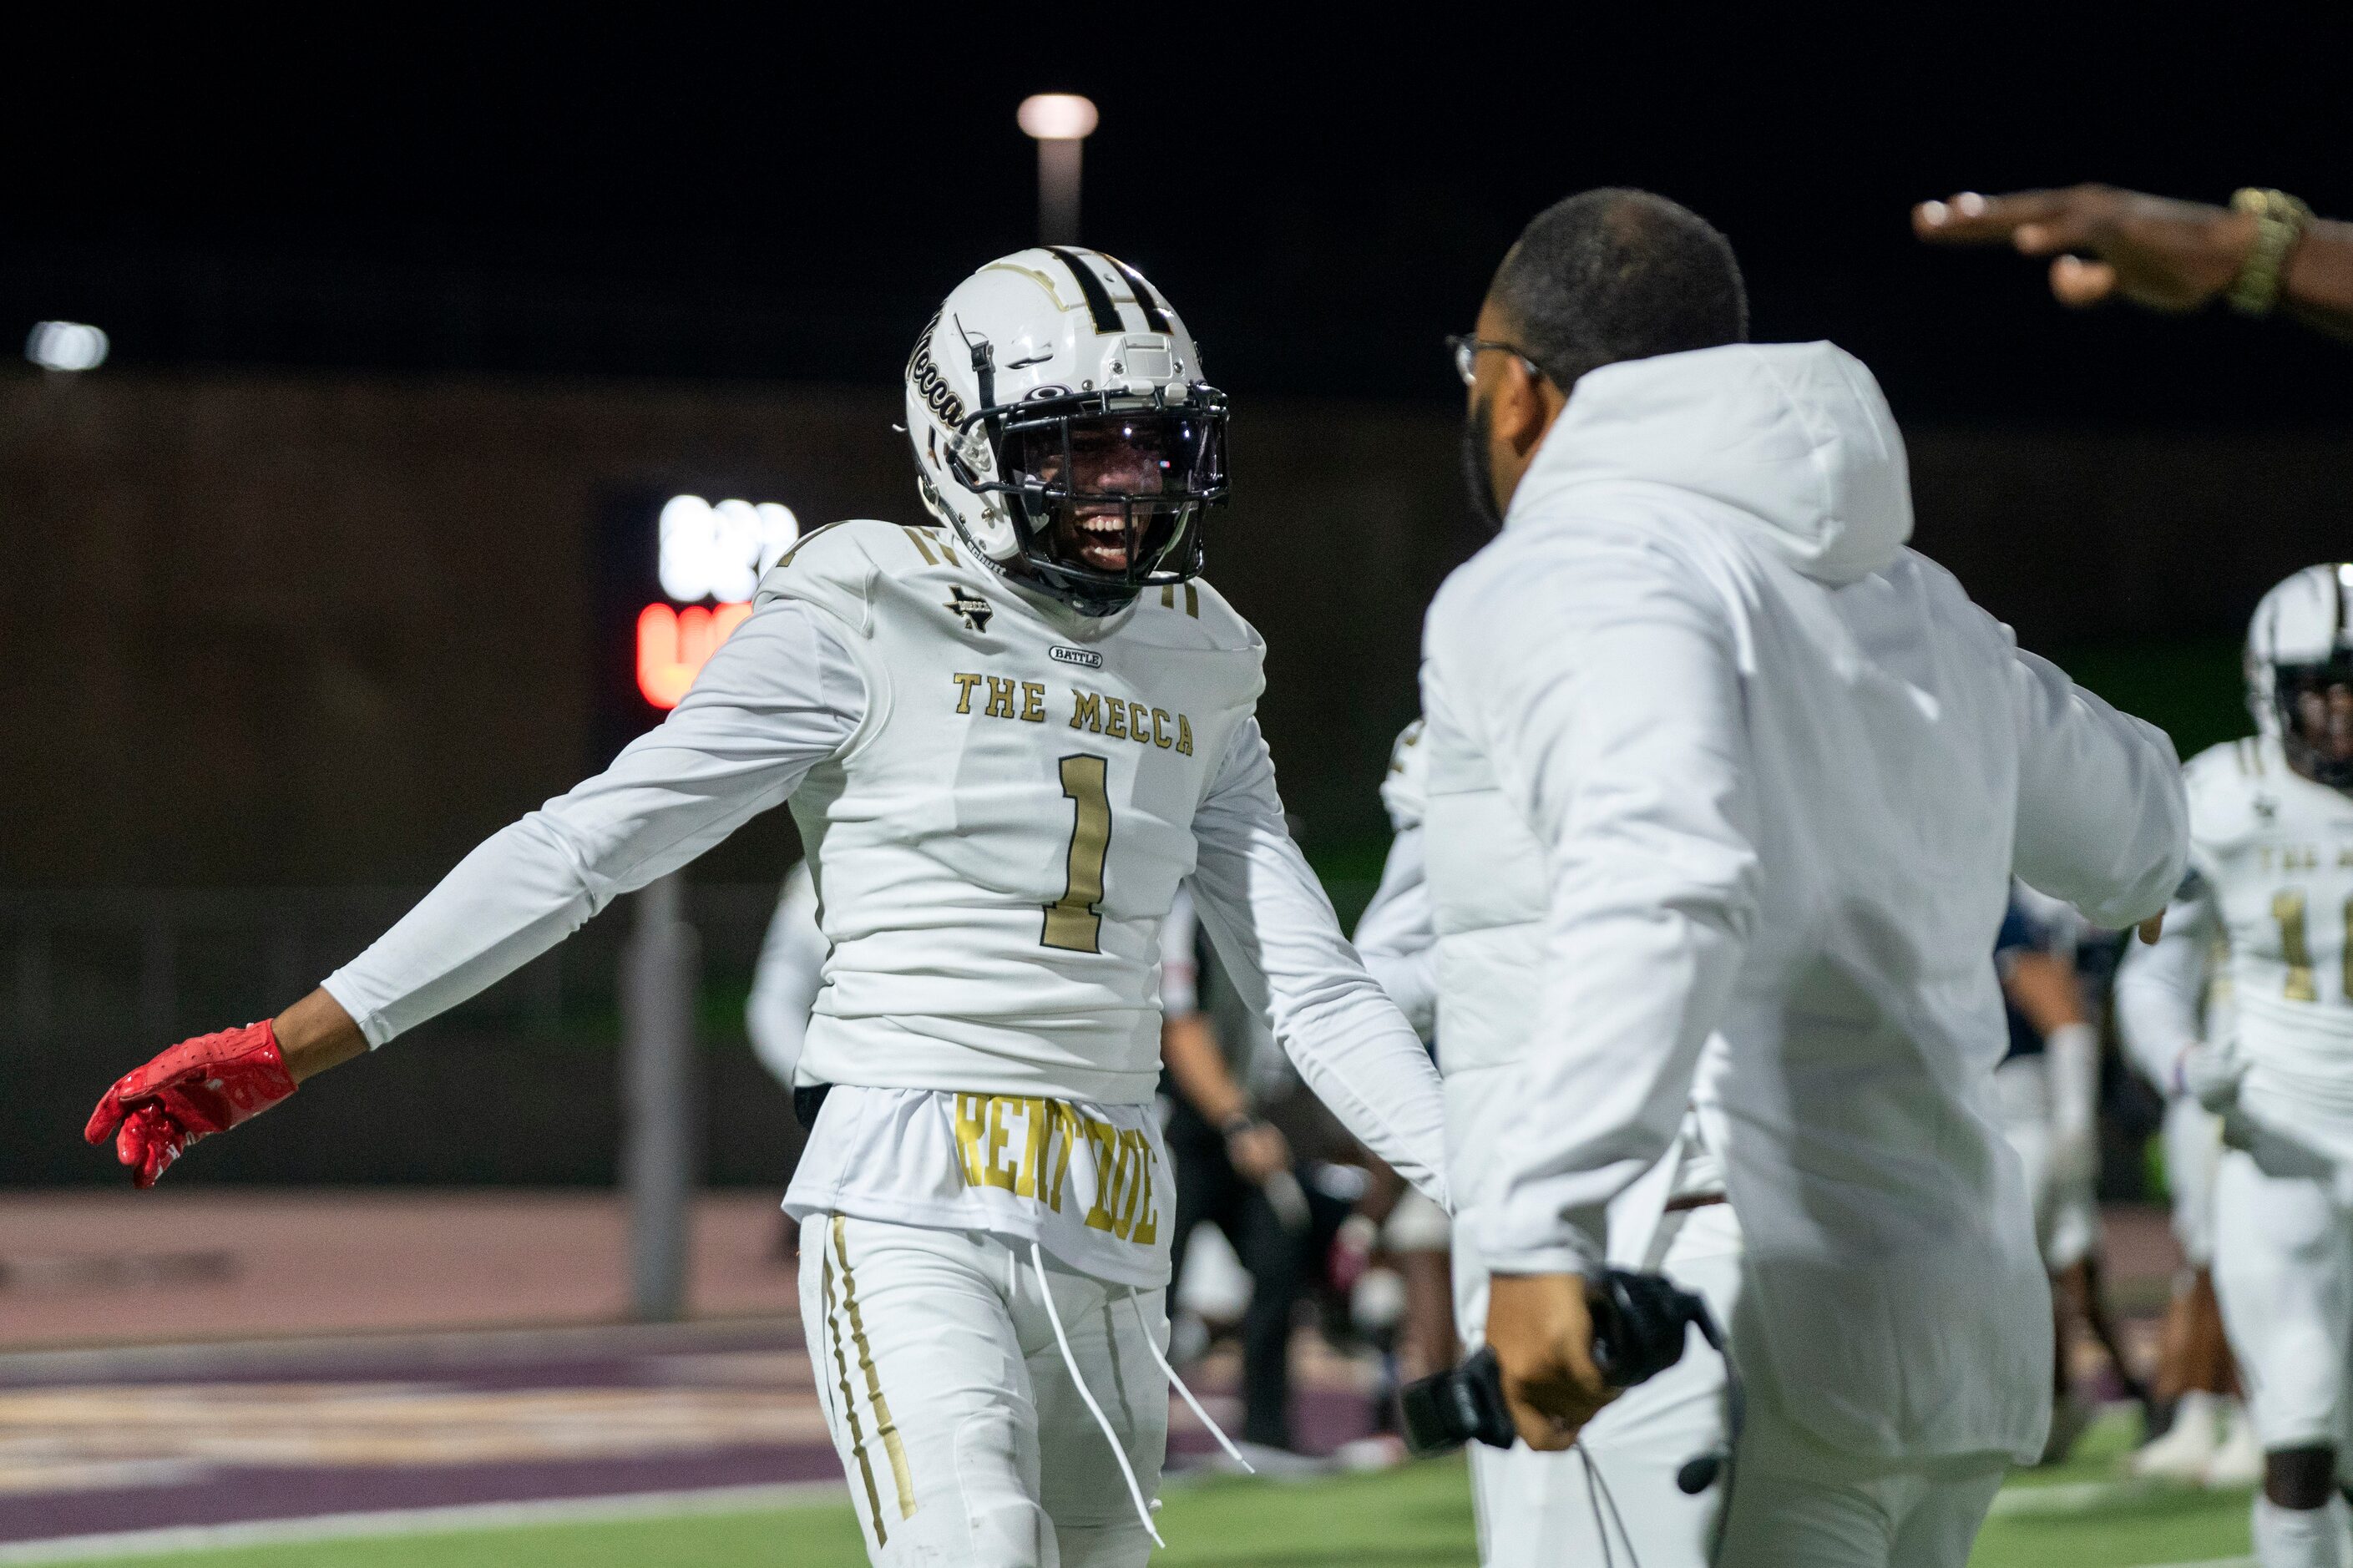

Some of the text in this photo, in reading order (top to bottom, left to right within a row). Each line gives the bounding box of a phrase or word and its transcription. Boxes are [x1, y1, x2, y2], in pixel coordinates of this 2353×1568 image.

[1054, 649, 1100, 666] BATTLE
[954, 673, 1194, 756] THE MECCA
[1040, 752, 1112, 954] 1
